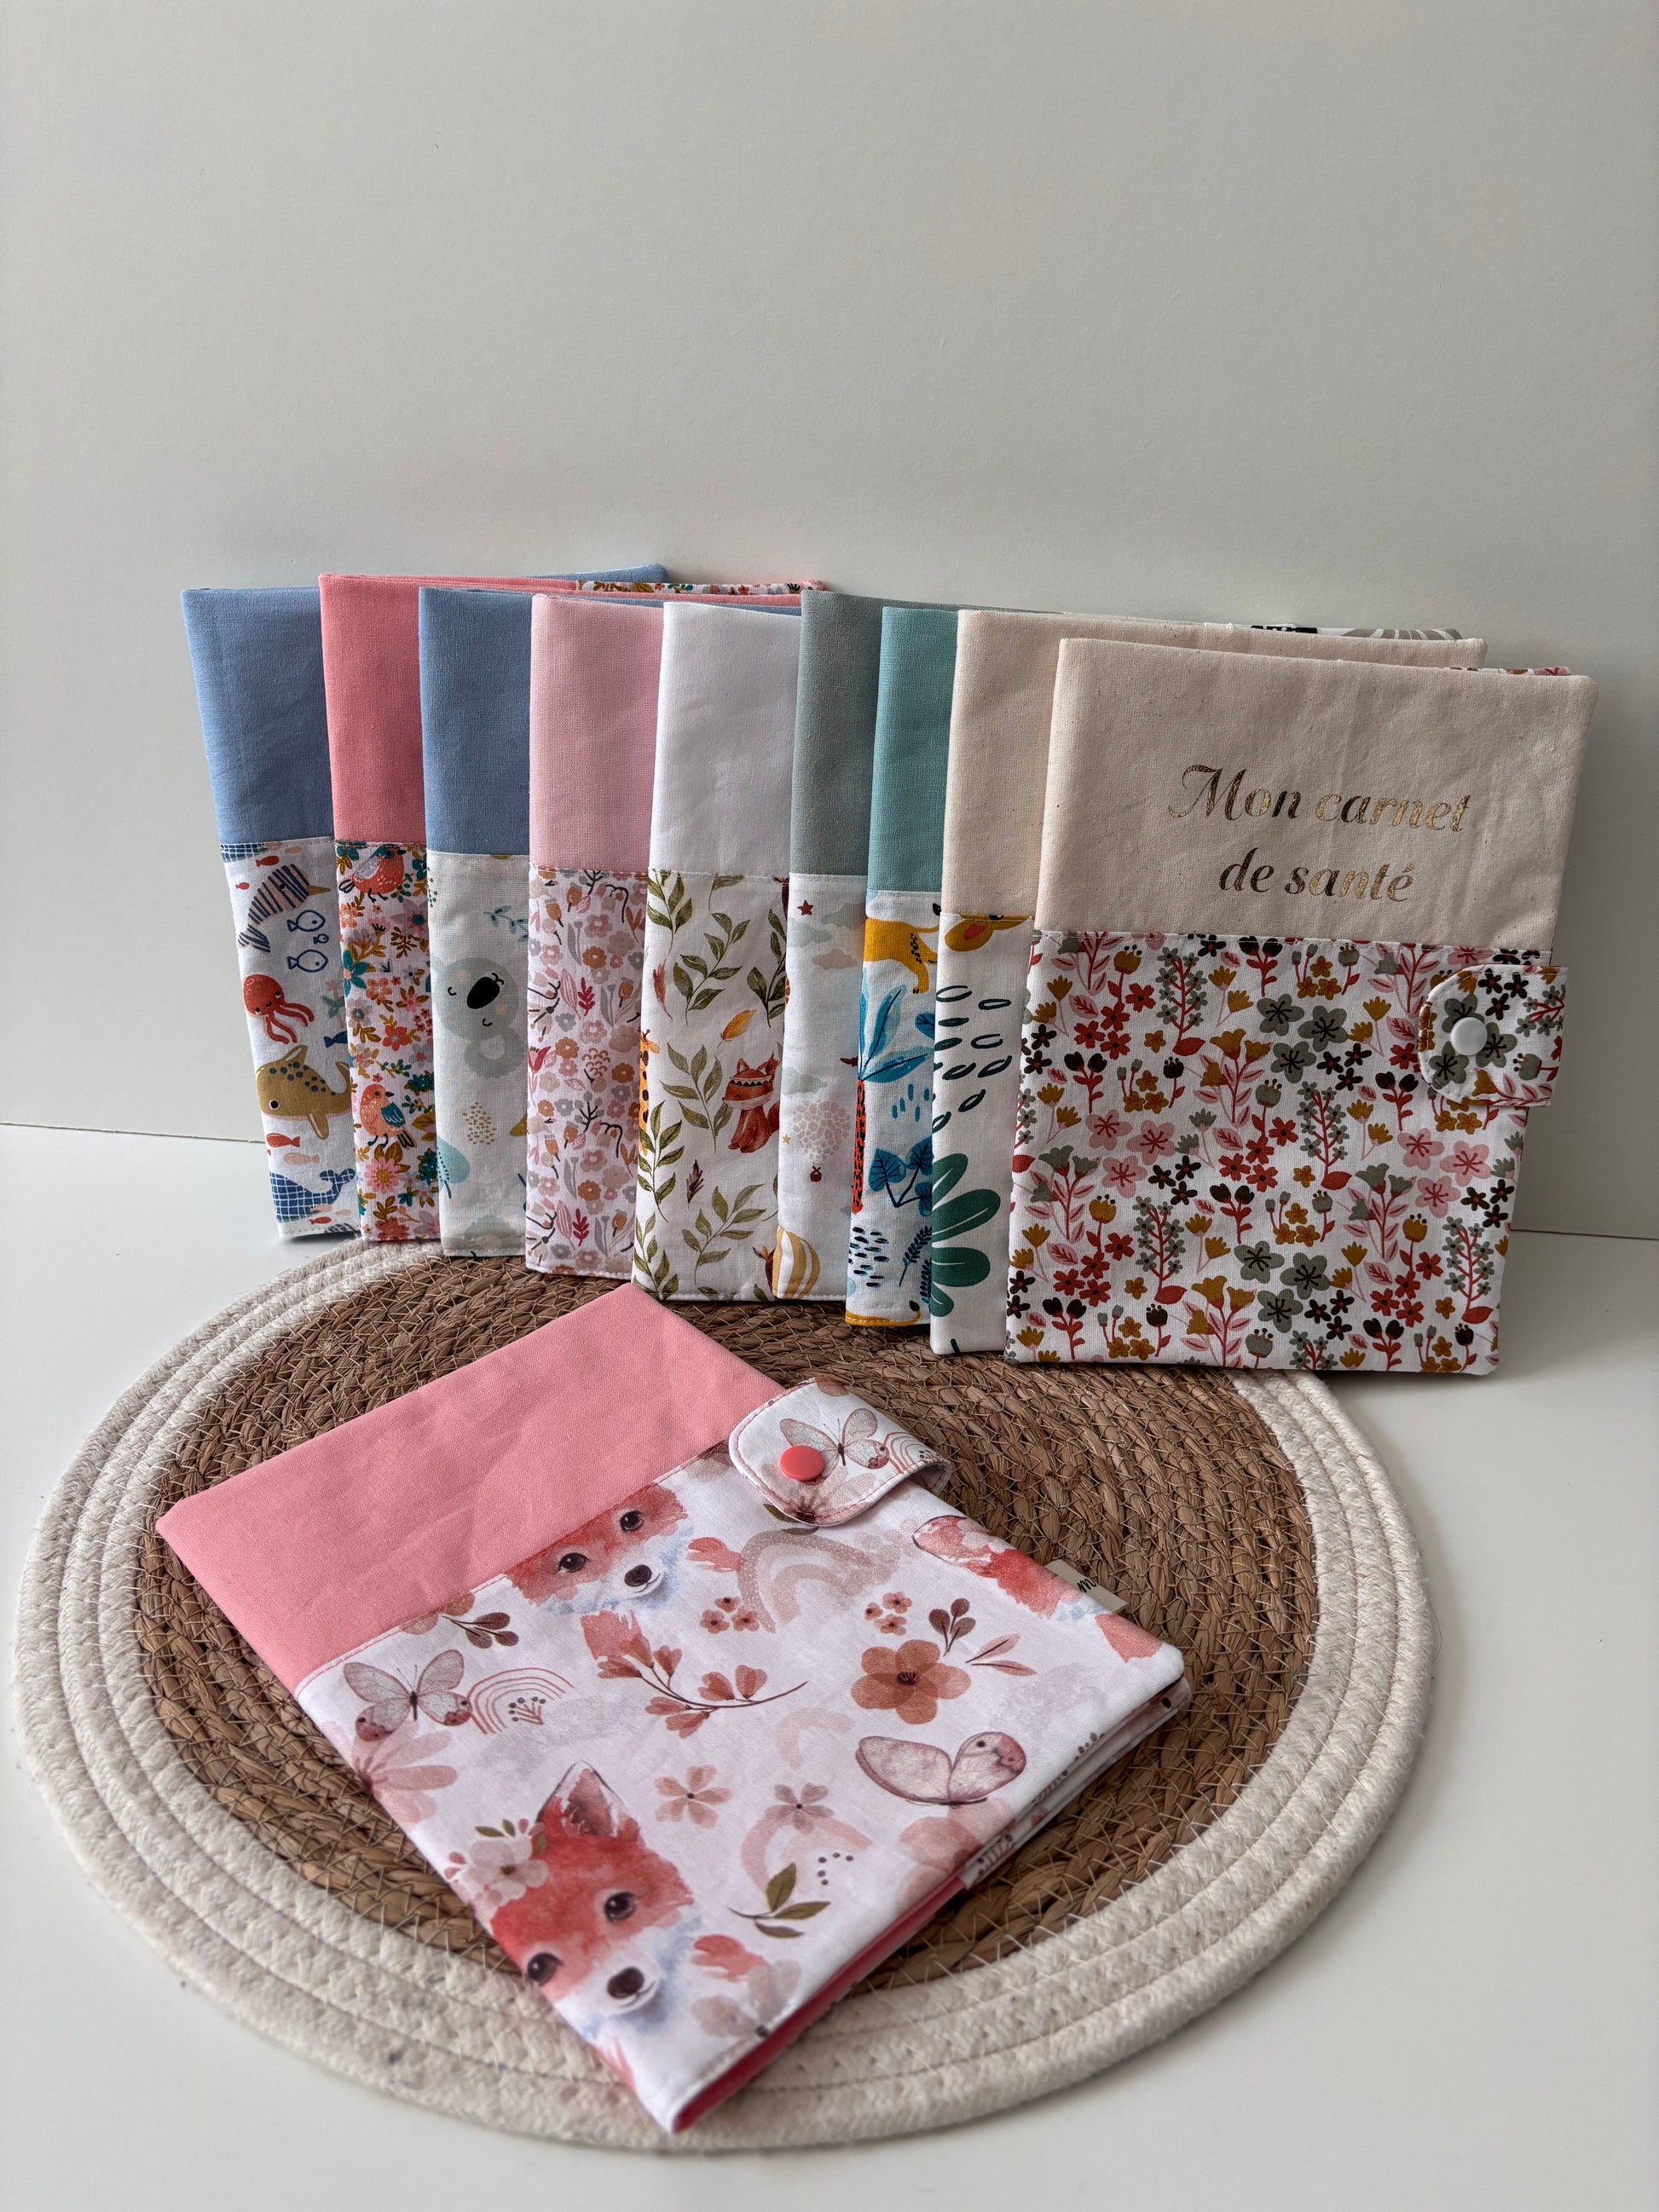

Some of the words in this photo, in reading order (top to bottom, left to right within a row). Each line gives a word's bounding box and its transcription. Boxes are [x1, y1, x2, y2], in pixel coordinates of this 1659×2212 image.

[1168, 764, 1301, 821] Mon
[1315, 794, 1471, 832] carnet
[1218, 847, 1275, 893] de
[1284, 863, 1415, 903] santé
